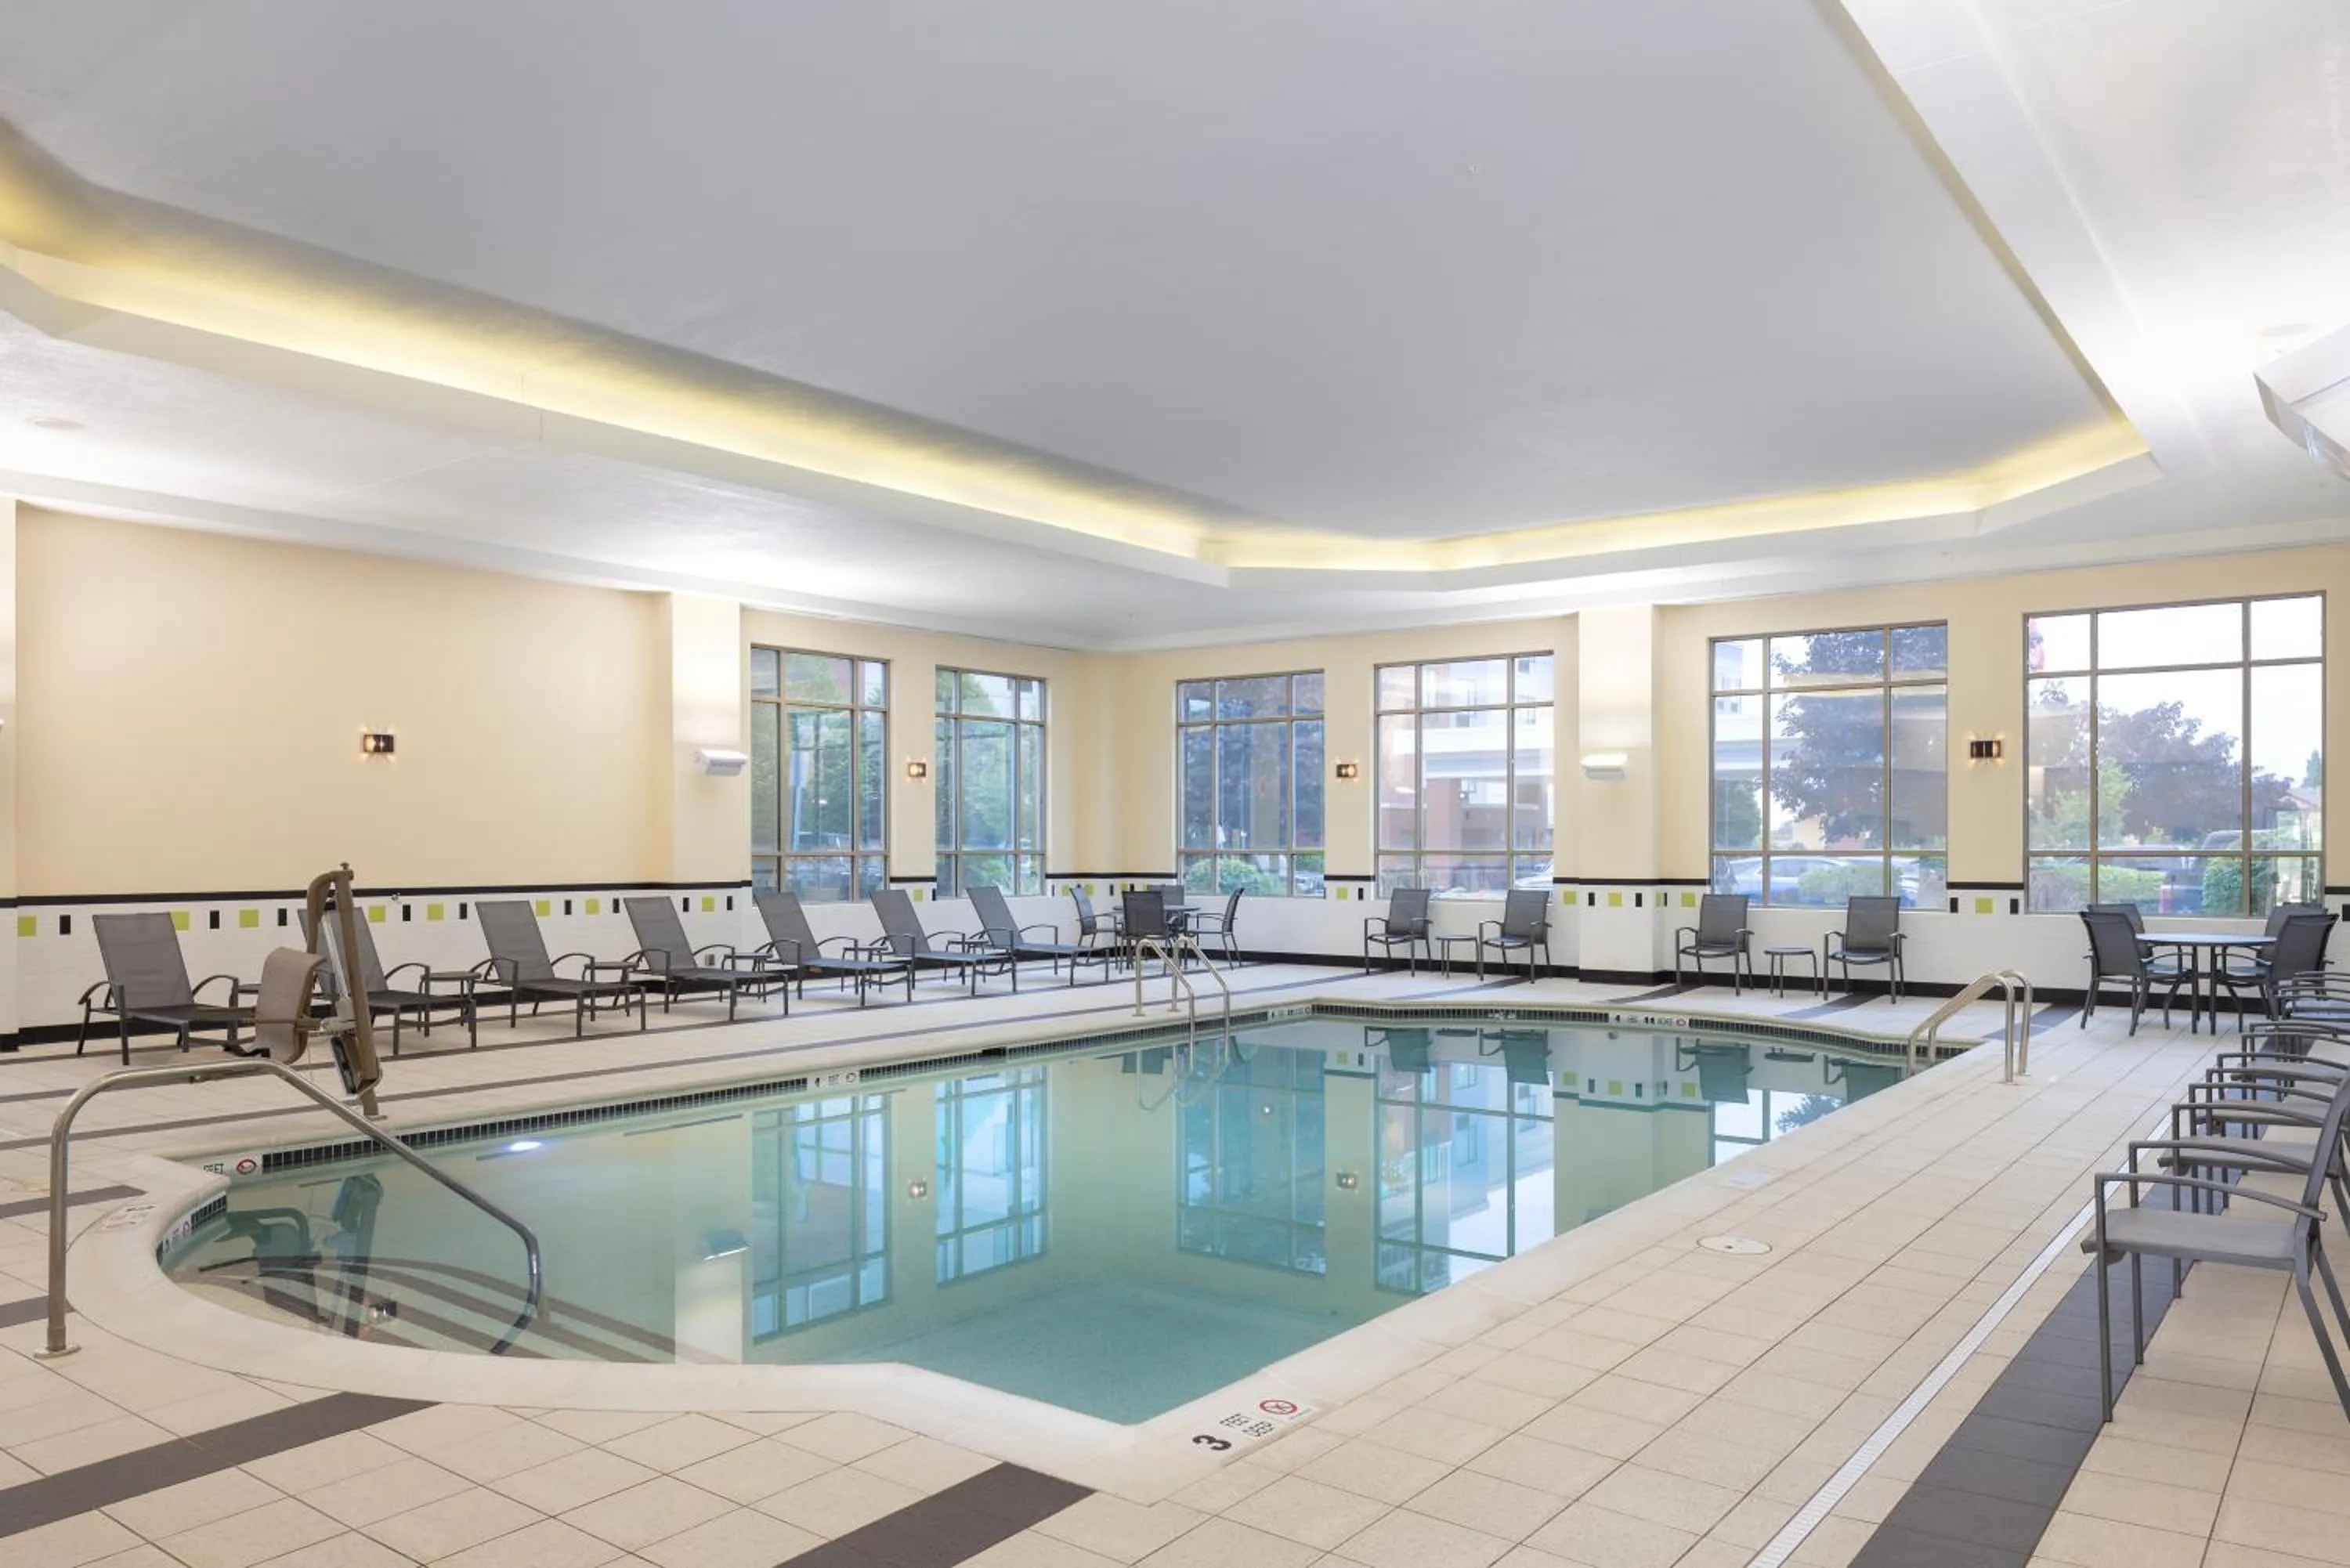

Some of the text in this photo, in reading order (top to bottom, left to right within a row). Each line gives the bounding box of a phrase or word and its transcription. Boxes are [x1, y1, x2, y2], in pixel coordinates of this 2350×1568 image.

[1218, 1412, 1250, 1429] FEET
[1242, 1420, 1274, 1437] DEEP
[1191, 1434, 1233, 1451] 3
